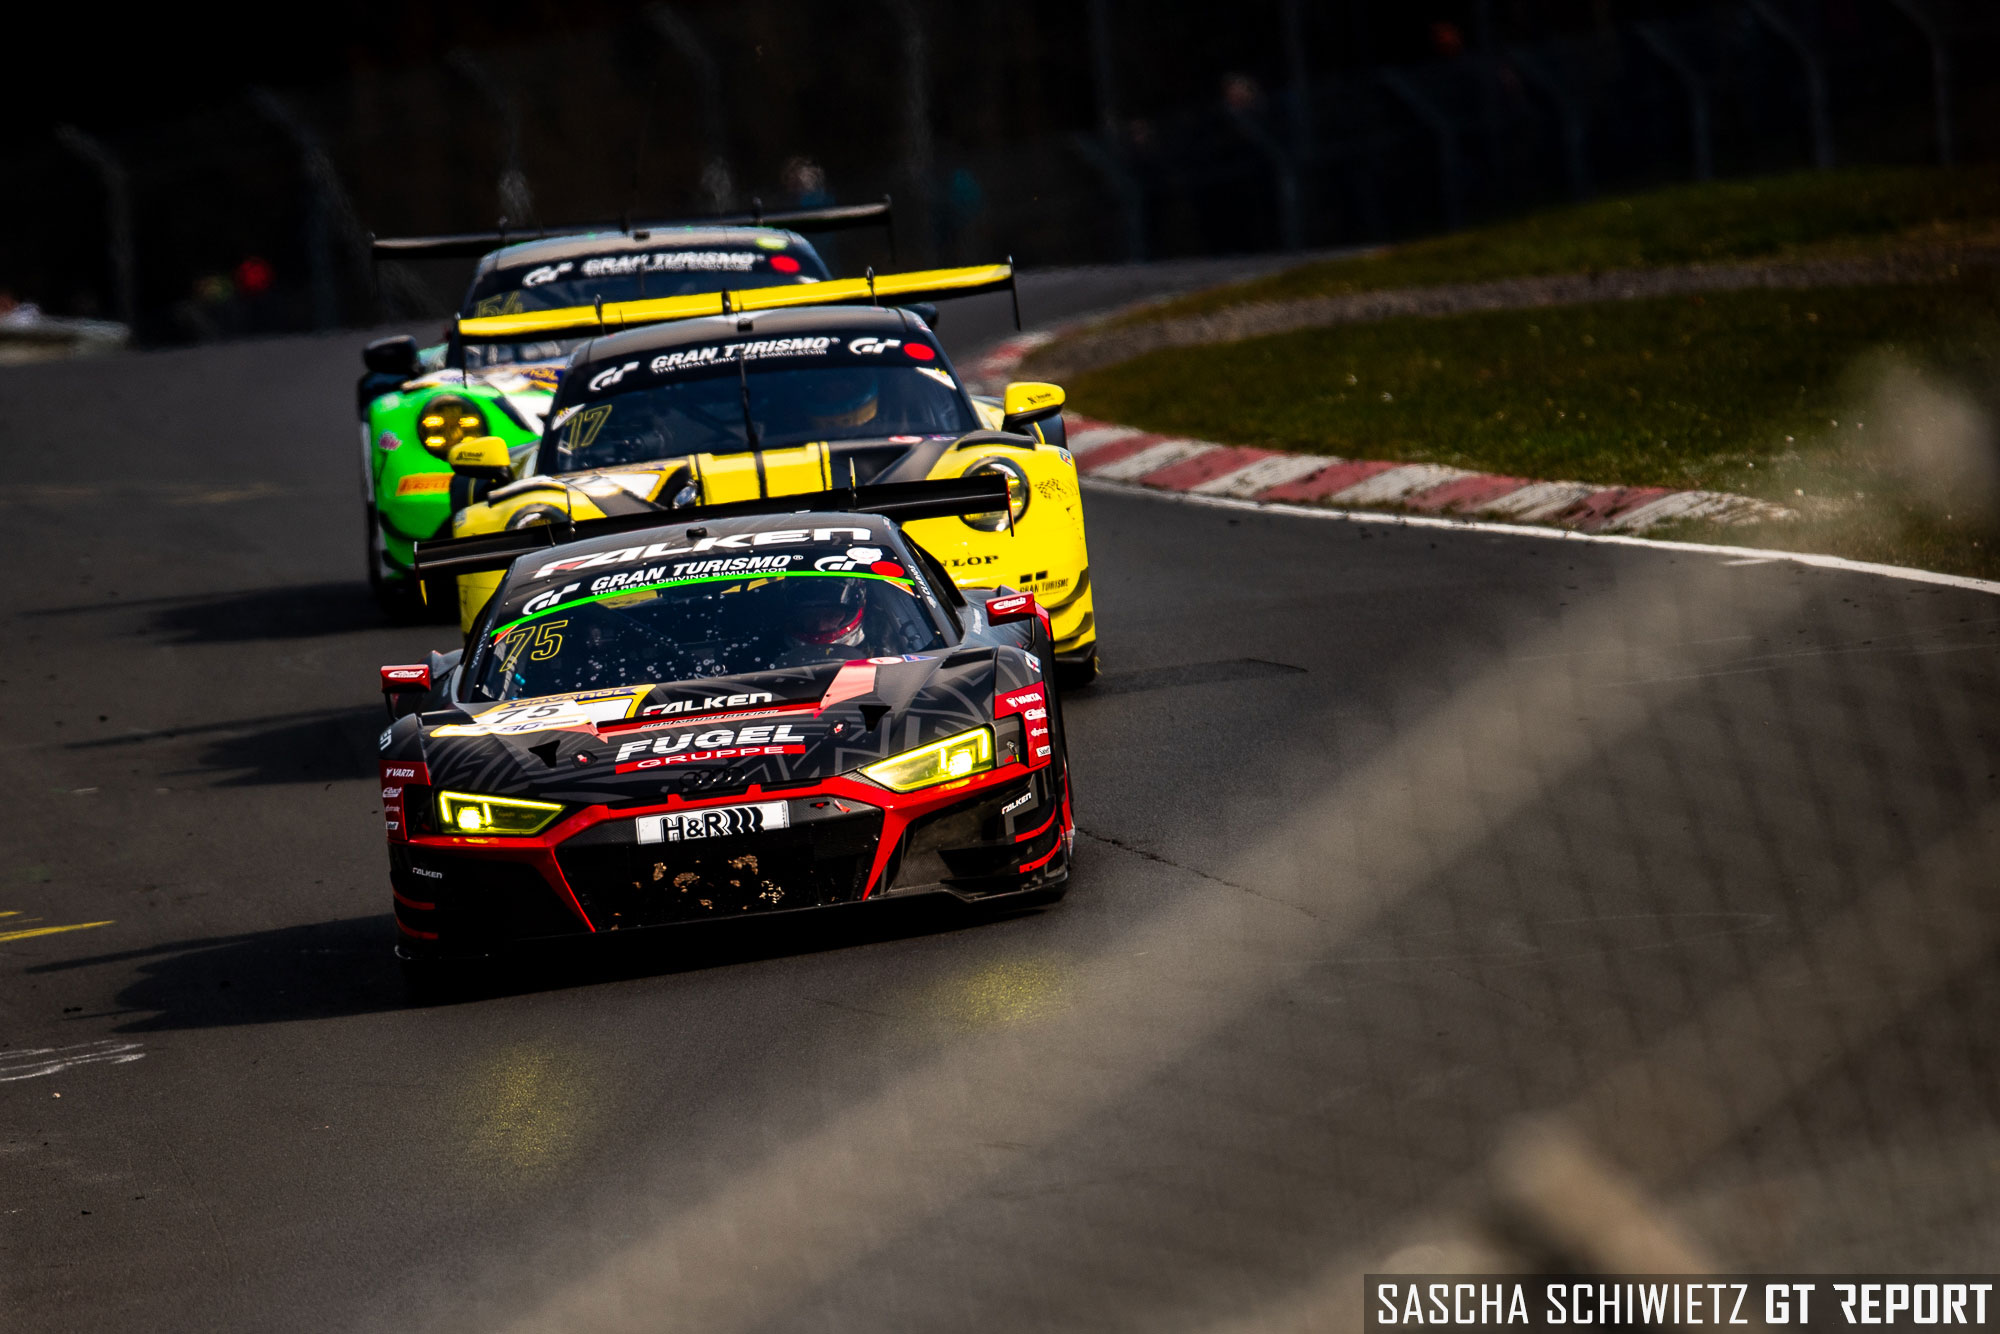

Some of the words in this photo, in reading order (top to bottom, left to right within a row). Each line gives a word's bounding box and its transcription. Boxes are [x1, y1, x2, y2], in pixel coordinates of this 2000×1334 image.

[588, 360, 640, 391] GT
[650, 344, 719, 369] GRAN
[849, 337, 901, 355] GT
[565, 404, 613, 451] 17
[533, 527, 871, 579] FALKEN
[656, 573, 709, 584] DRIVING
[712, 567, 787, 577] SIMULATOR
[522, 582, 582, 615] GT
[590, 565, 667, 592] GRAN
[499, 619, 569, 673] 75
[493, 703, 565, 724] 75
[642, 692, 773, 717] FALKEN
[615, 724, 805, 762] FUGEL
[637, 746, 785, 768] GRUPPE
[392, 768, 415, 778] VARTA
[1001, 792, 1032, 815] FALKEN
[661, 812, 728, 843] H&R
[412, 866, 443, 880] FALKEN
